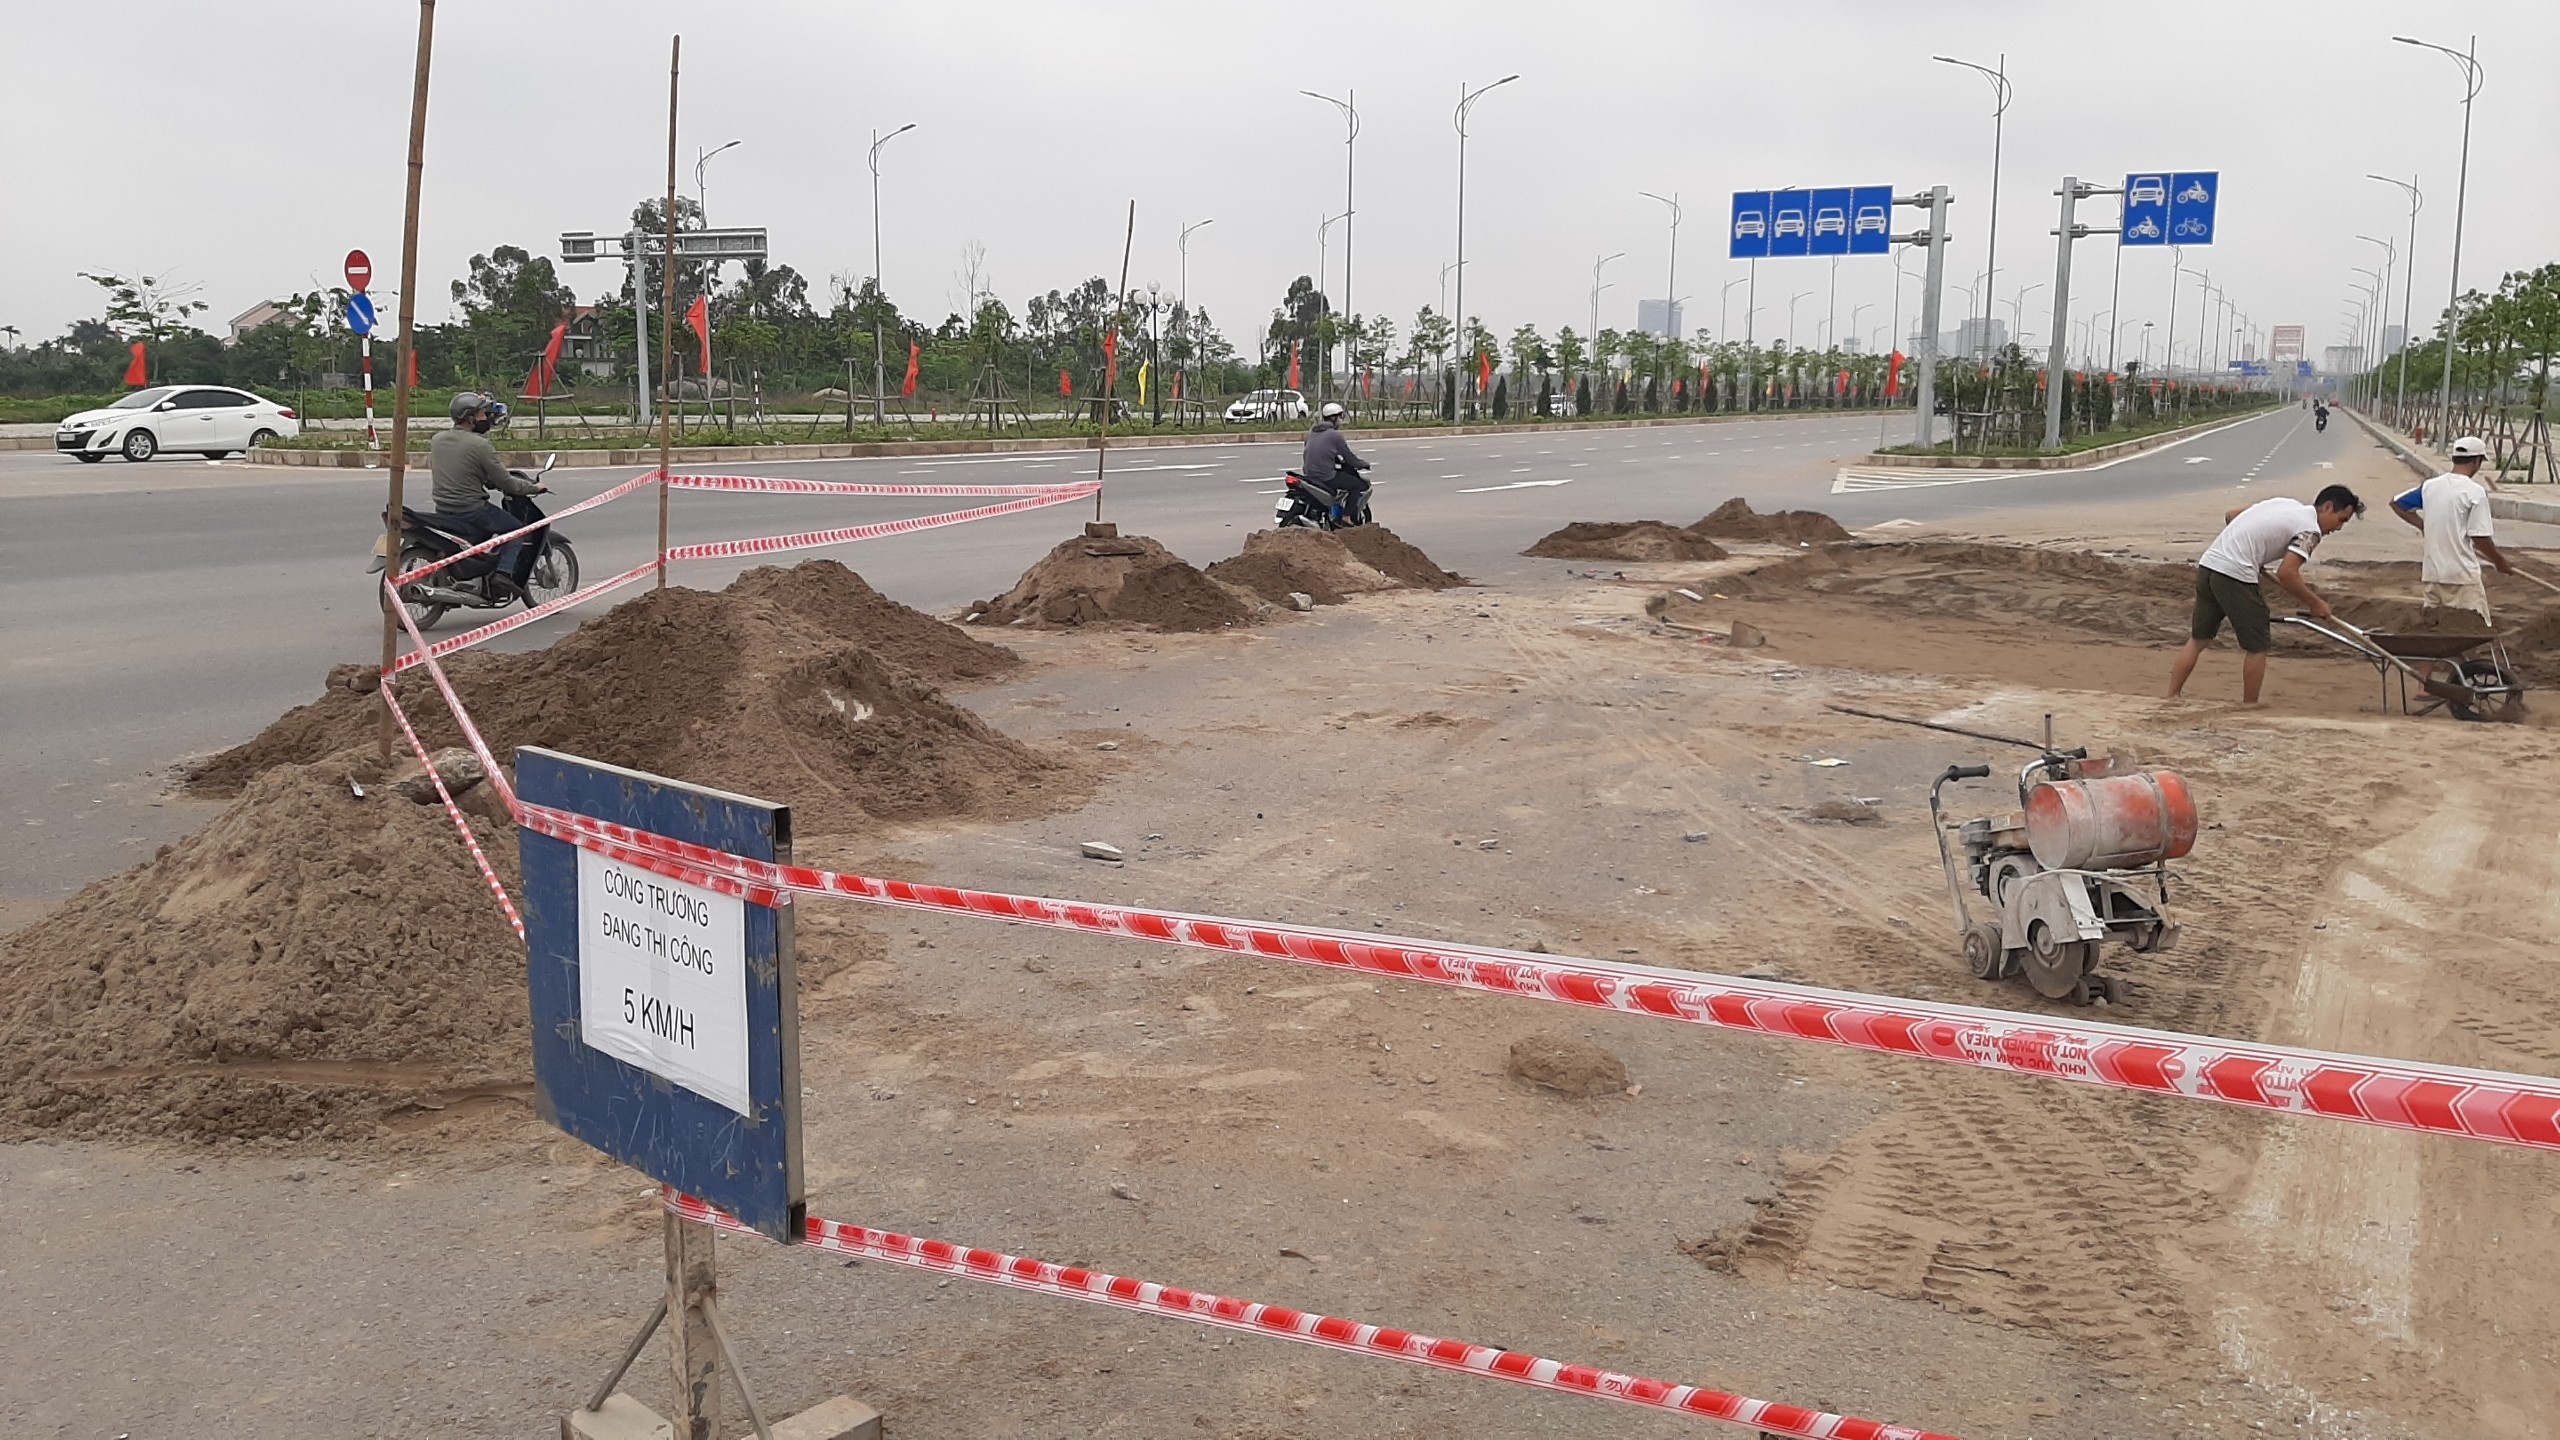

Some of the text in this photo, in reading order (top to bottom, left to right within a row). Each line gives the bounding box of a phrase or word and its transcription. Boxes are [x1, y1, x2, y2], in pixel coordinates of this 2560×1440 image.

[604, 867, 709, 927] CÔNG TRƯỜNG
[602, 912, 713, 975] ĐANG THI CÔNG
[624, 987, 694, 1050] 5 KM/H
[1966, 1031, 2001, 1049] AREA
[2060, 1046, 2088, 1061] NOT
[2060, 1062, 2087, 1076] KHU
